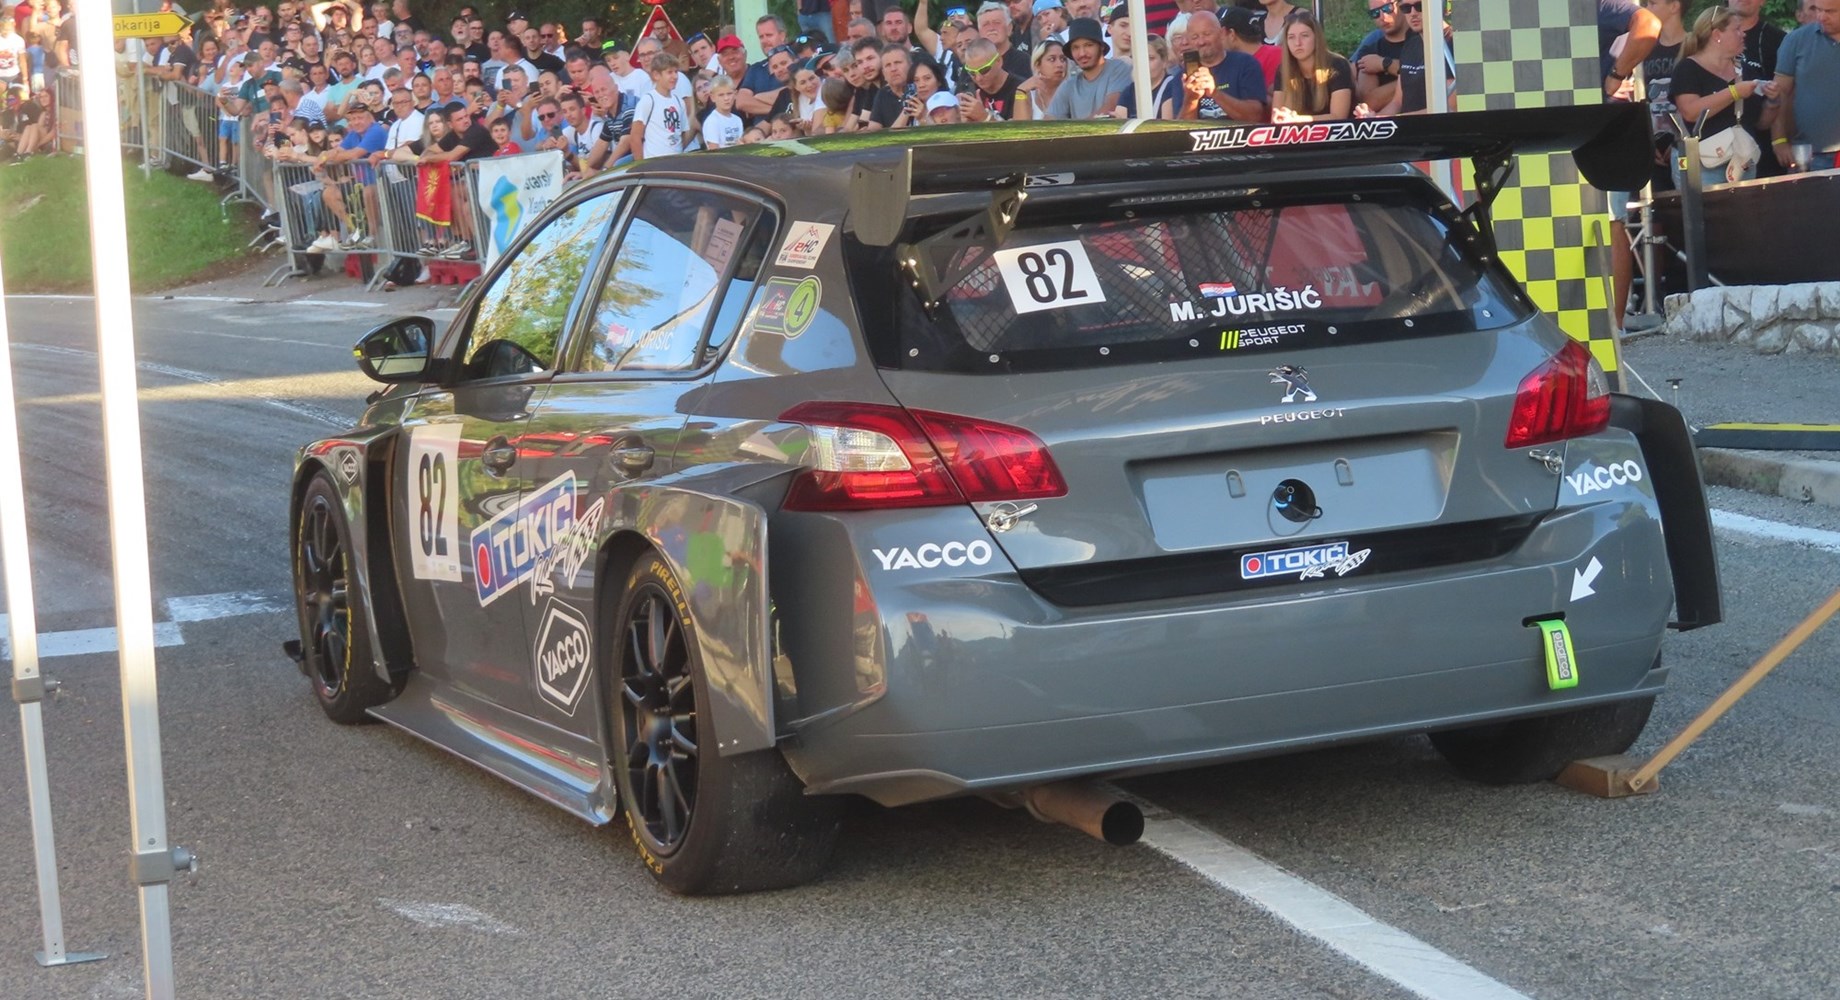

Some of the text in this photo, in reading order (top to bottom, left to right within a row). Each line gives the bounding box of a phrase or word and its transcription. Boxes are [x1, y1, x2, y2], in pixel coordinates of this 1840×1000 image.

[114, 20, 160, 32] okarija
[1017, 247, 1089, 304] 82
[794, 292, 809, 322] 4
[1169, 284, 1322, 322] M. JURIŠIĆ
[1238, 335, 1280, 348] SPORT
[1239, 324, 1306, 339] PEUGEOT
[1260, 407, 1346, 426] PEUGEOT
[1565, 459, 1643, 496] YACCO
[419, 451, 448, 557] 82
[493, 485, 571, 577] TOKIĆ
[871, 539, 993, 571] YACCO
[1267, 544, 1343, 570] TOKIĆ
[650, 560, 691, 626] PIRELLI
[542, 630, 585, 682] YACCO
